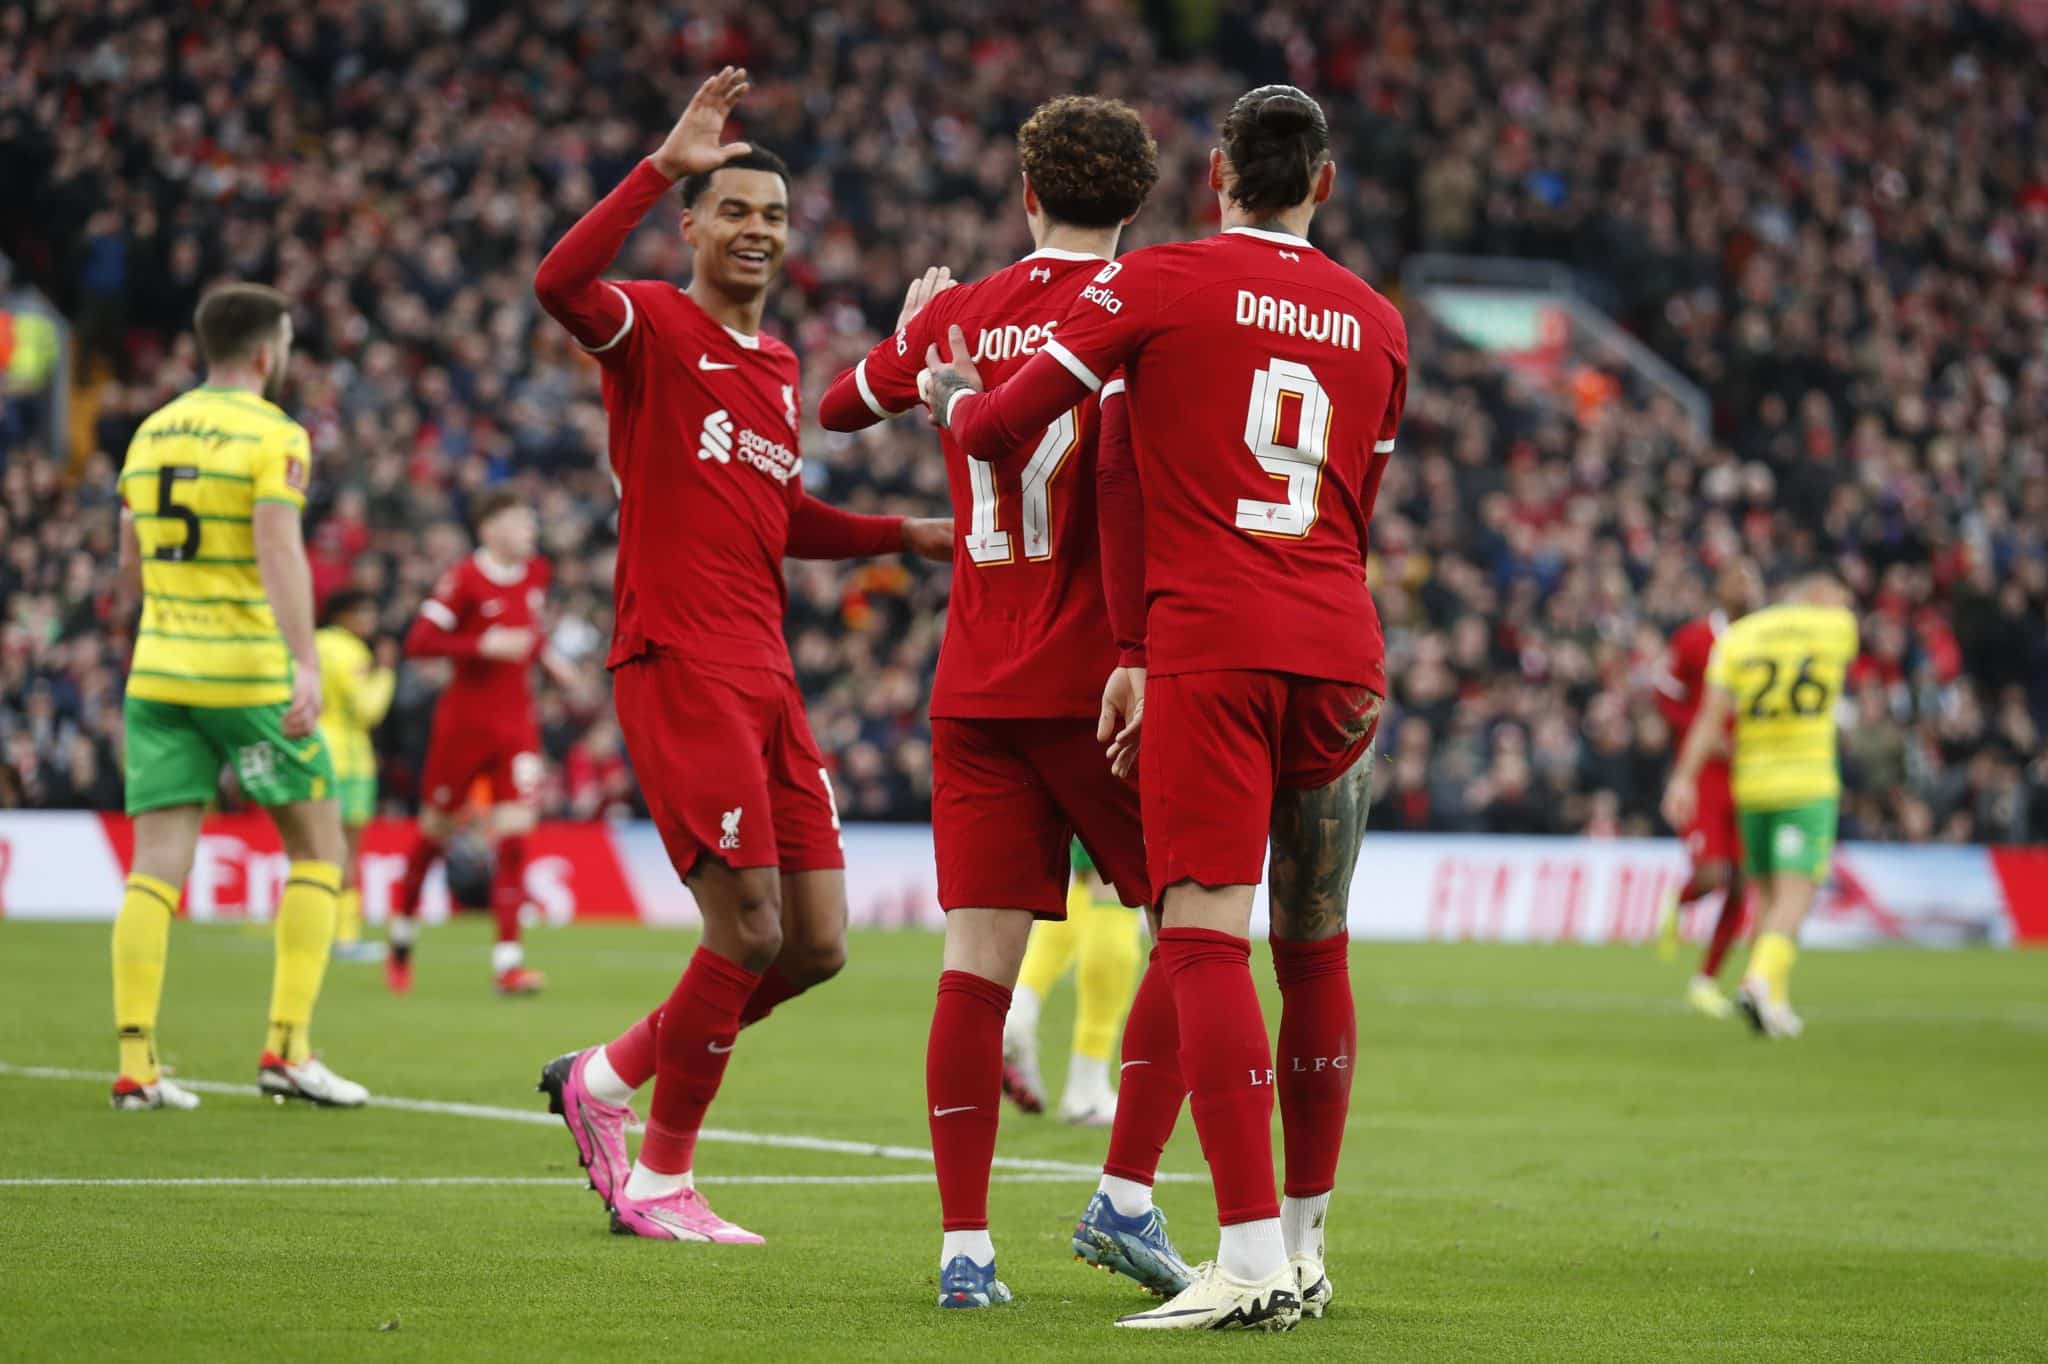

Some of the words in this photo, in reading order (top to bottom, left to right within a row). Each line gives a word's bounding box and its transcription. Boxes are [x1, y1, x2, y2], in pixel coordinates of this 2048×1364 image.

[1236, 289, 1360, 351] DARWIN
[965, 405, 1080, 567] 17
[1235, 357, 1333, 540] 9
[156, 465, 201, 562] 5
[1741, 656, 1828, 719] 26
[1293, 1055, 1348, 1072] LFC
